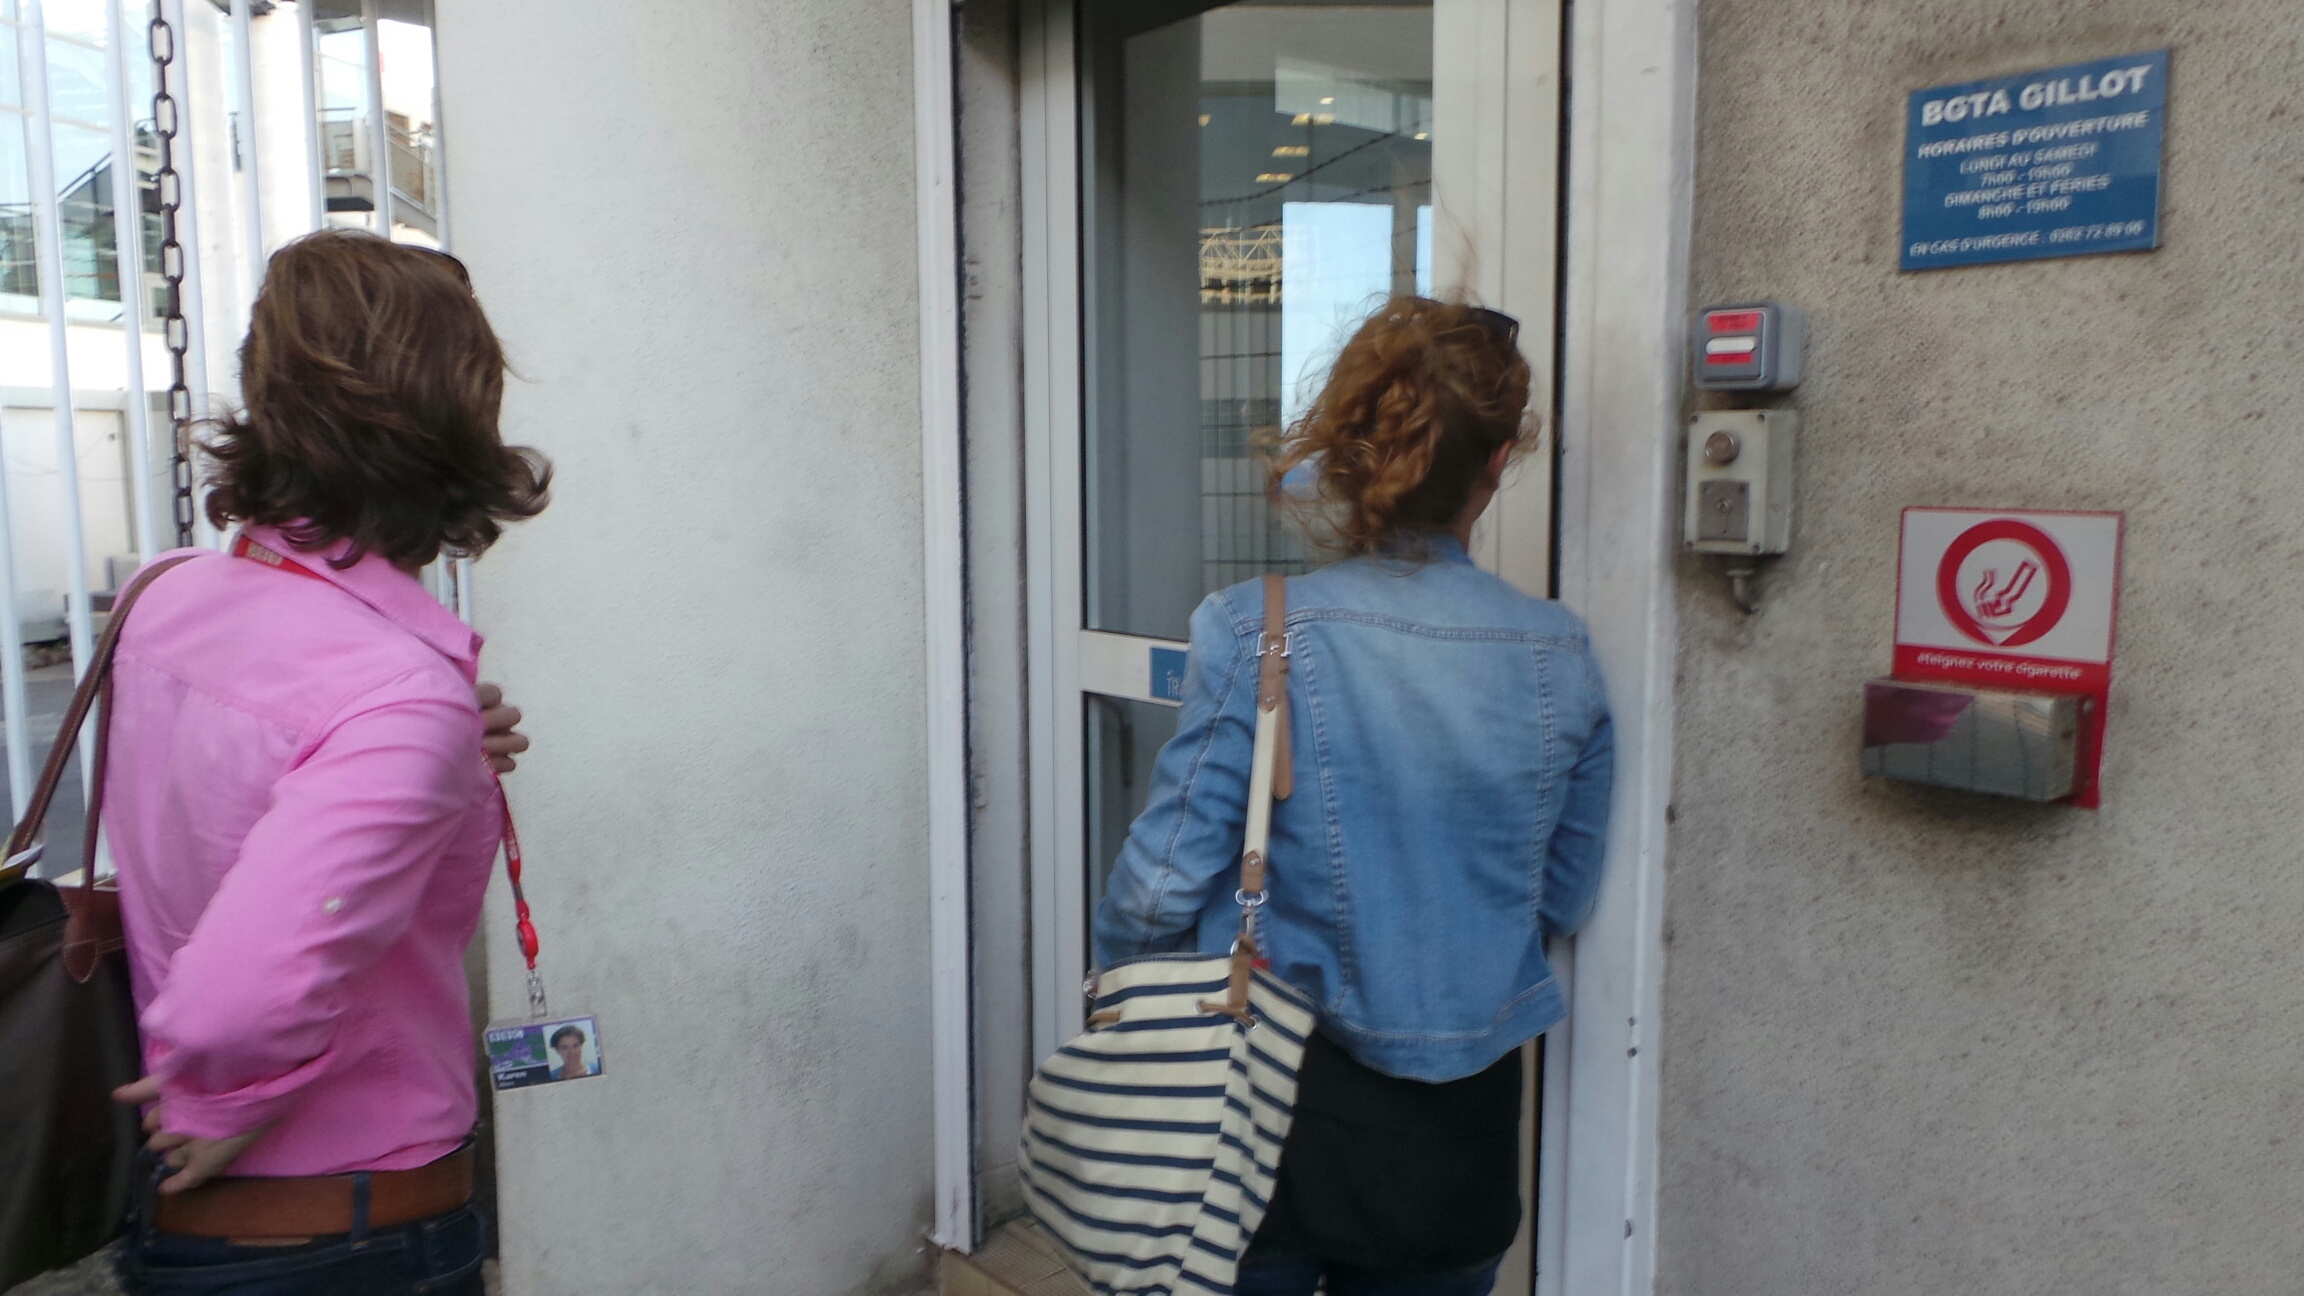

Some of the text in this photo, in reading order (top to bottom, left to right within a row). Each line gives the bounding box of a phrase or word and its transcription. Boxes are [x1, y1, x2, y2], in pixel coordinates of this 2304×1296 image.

[2019, 65, 2152, 110] GILLOT
[1917, 110, 2150, 159] HORAIRES D'OUVERTURE
[1959, 142, 2099, 175] LUNDI AU SAMEDI
[1944, 183, 2027, 208] DIMANCHE
[2026, 180, 2049, 198] ET
[1976, 658, 2014, 673] votre
[2015, 662, 2083, 680] cigarette
